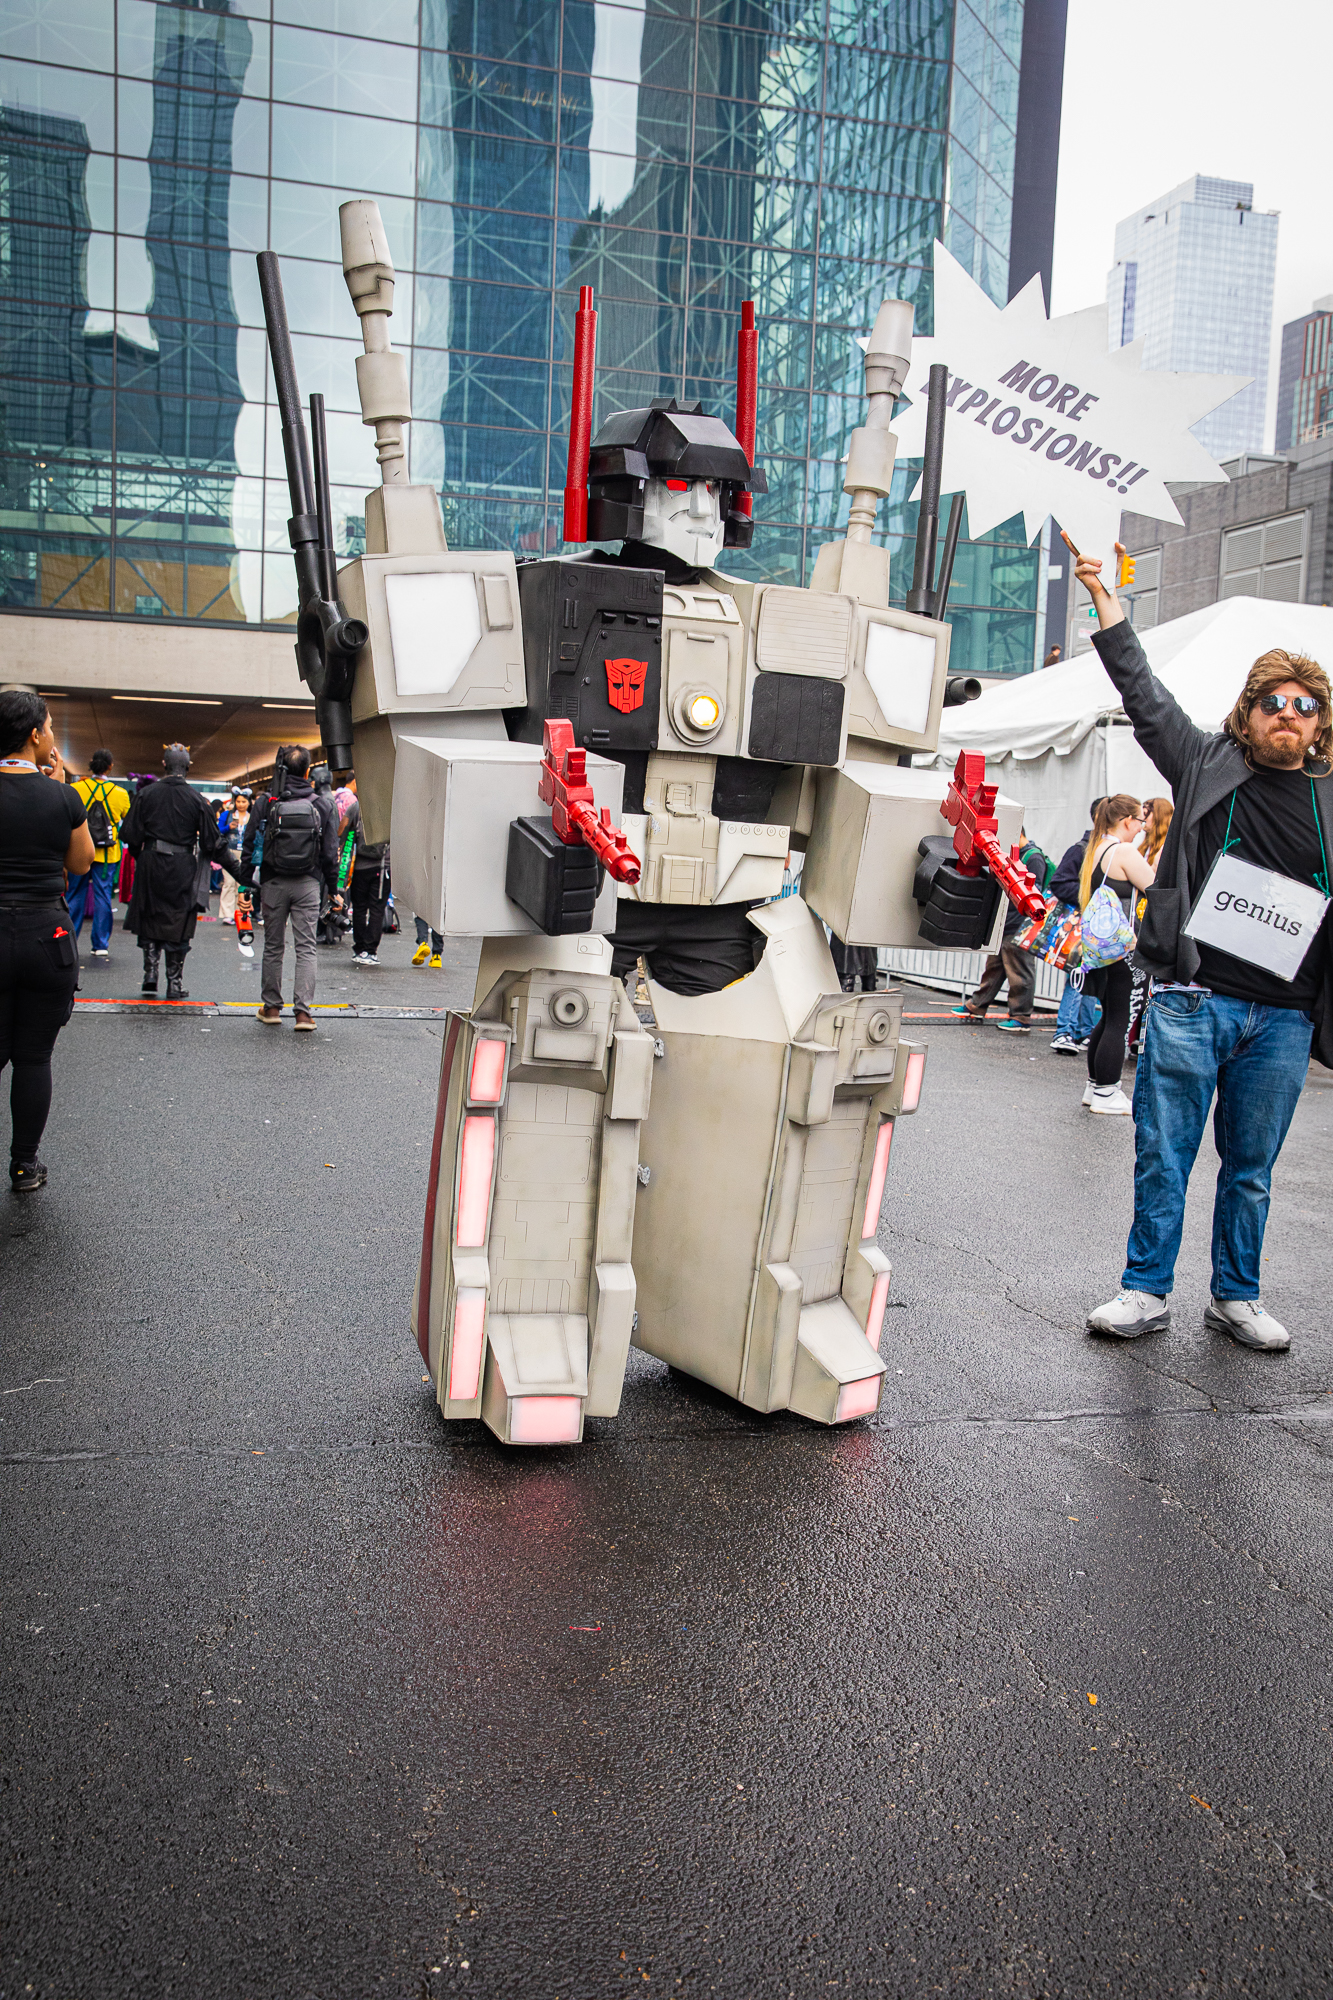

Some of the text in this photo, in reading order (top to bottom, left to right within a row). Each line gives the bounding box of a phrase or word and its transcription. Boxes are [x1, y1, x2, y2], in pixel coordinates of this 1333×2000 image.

[997, 360, 1100, 422] MORE
[919, 373, 1149, 494] XPLOSIONS!!
[338, 830, 355, 879] WEBTOON
[1213, 890, 1302, 936] genius
